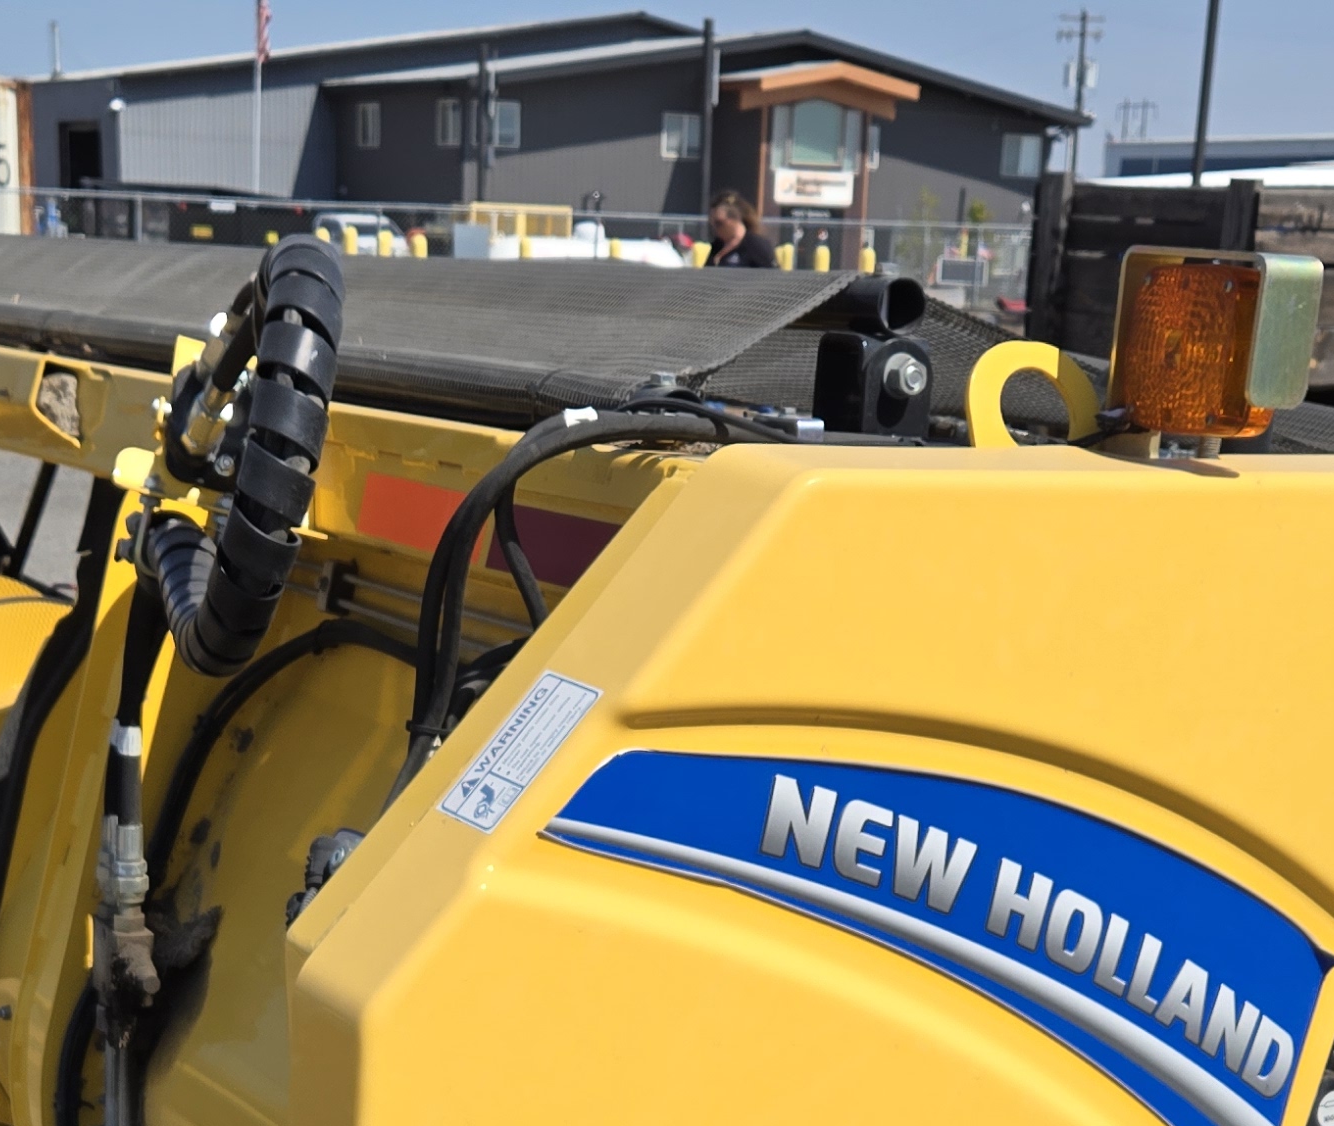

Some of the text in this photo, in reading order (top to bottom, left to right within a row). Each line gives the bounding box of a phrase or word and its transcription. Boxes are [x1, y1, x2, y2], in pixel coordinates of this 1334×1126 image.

[475, 687, 548, 772] WARNING
[760, 773, 1294, 1098] NEW HOLLAND
